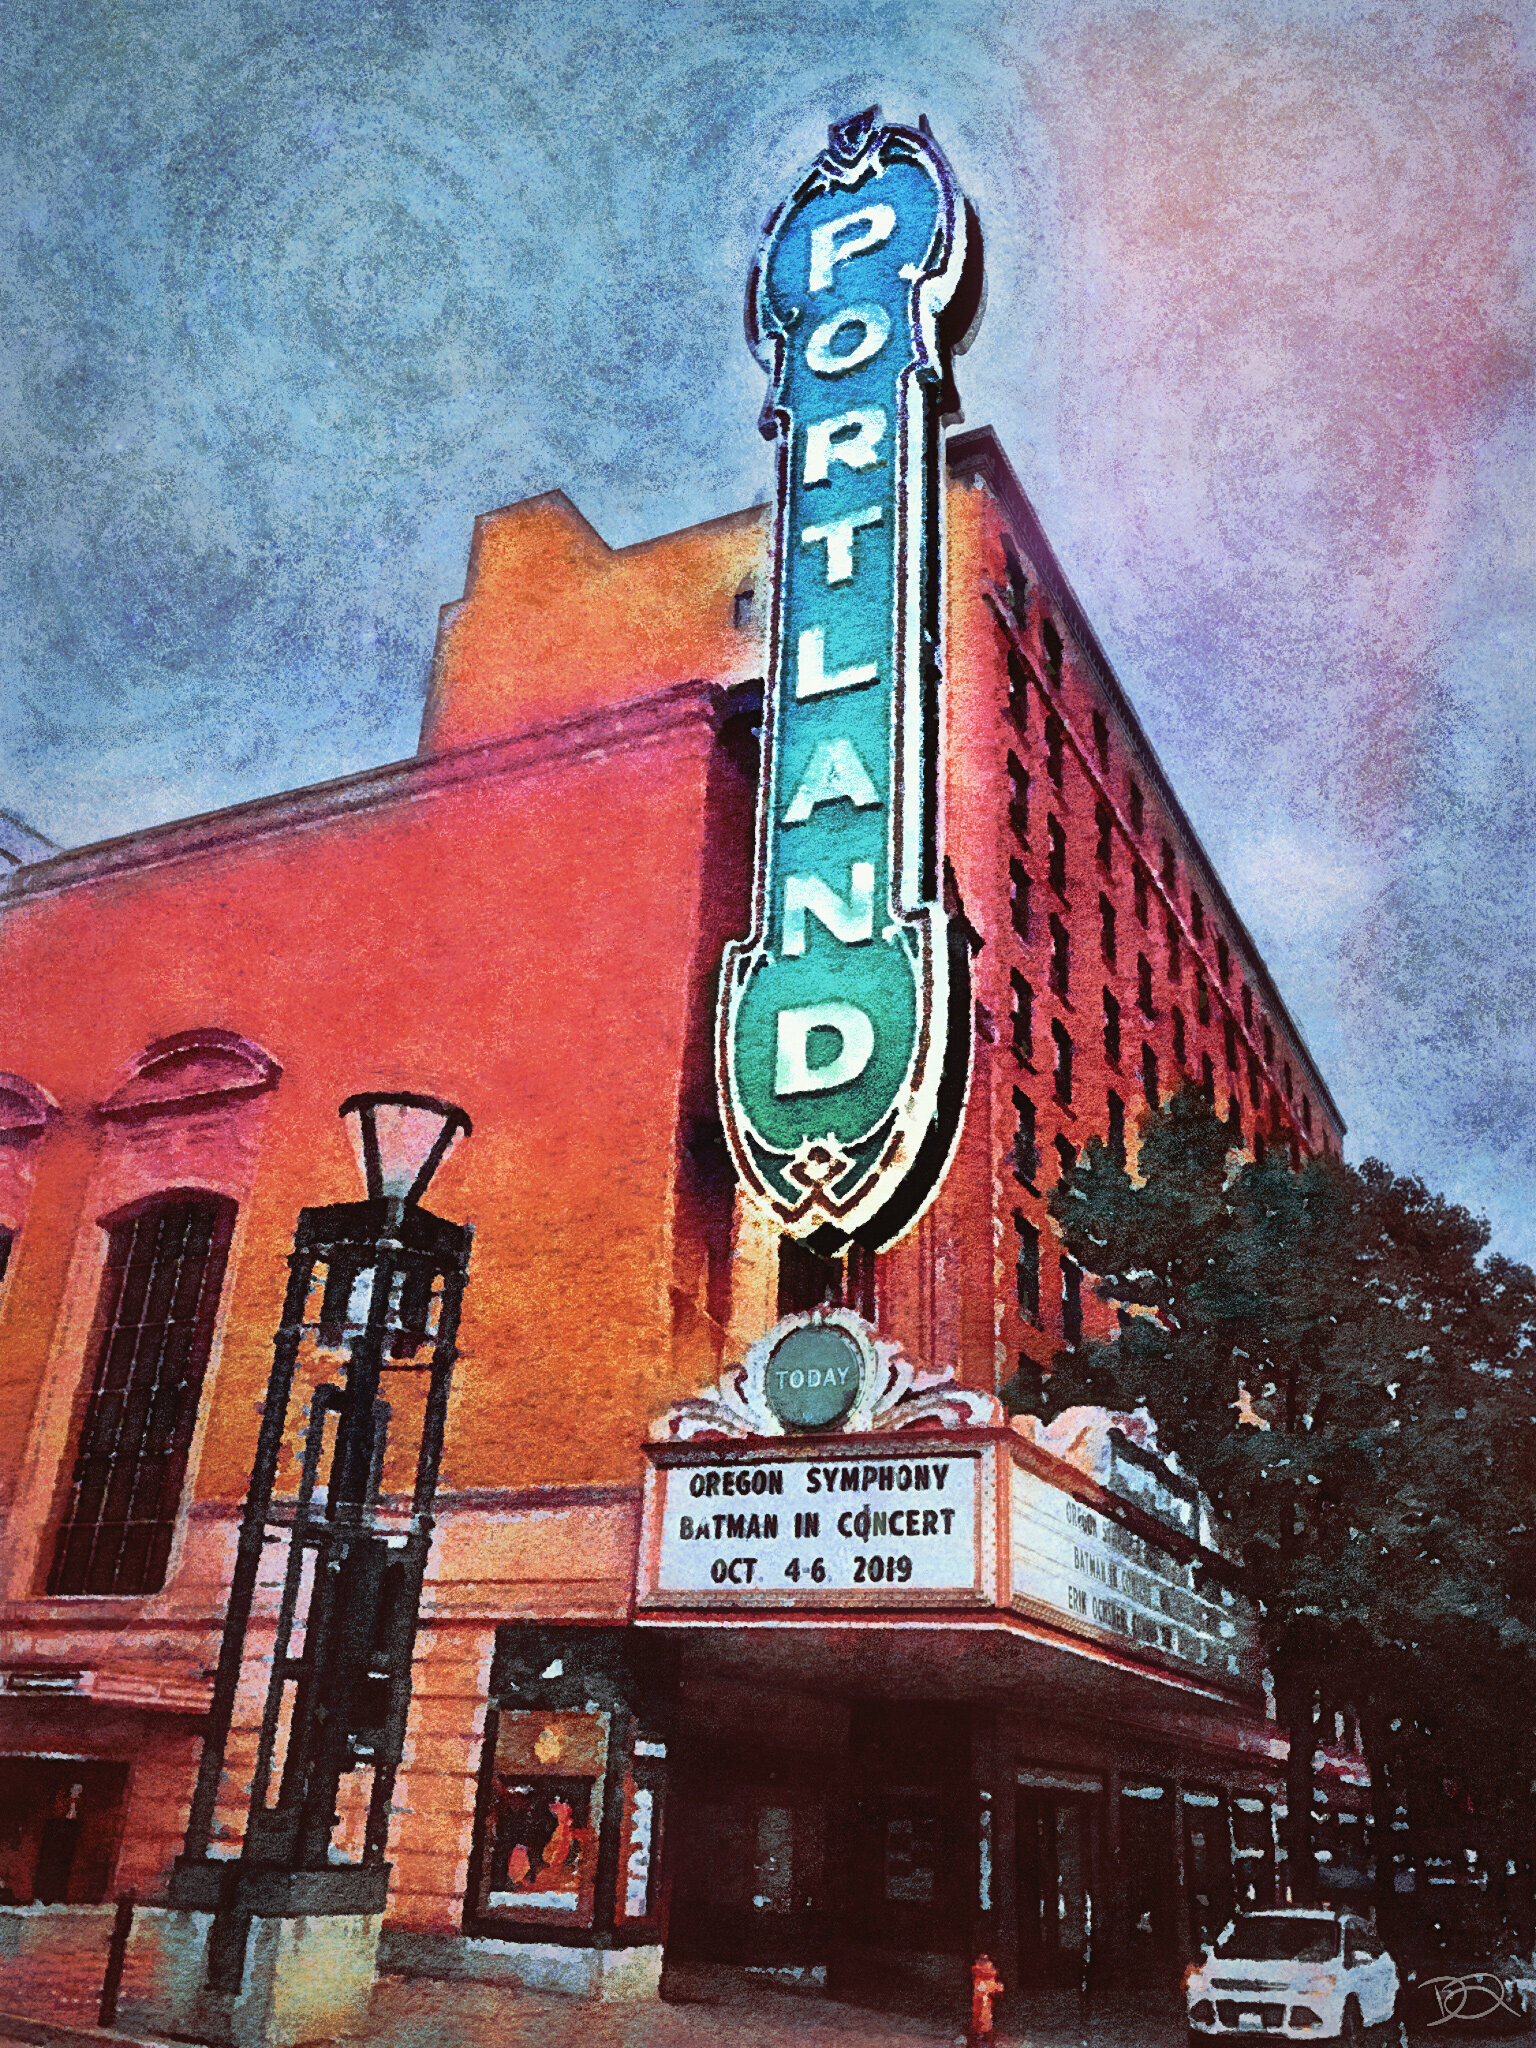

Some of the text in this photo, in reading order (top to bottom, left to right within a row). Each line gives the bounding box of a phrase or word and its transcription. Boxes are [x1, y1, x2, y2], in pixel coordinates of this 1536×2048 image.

[774, 202, 897, 1097] PORTLAND
[775, 1367, 850, 1390] TODAY
[689, 1464, 949, 1498] OREGON SYMPHONY
[680, 1506, 956, 1541] BATMAN IN CONCERT
[710, 1558, 758, 1584] OCT
[853, 1555, 914, 1584] 2019
[1073, 1546, 1106, 1583] BATMAN
[1068, 1585, 1087, 1615] ERIK
